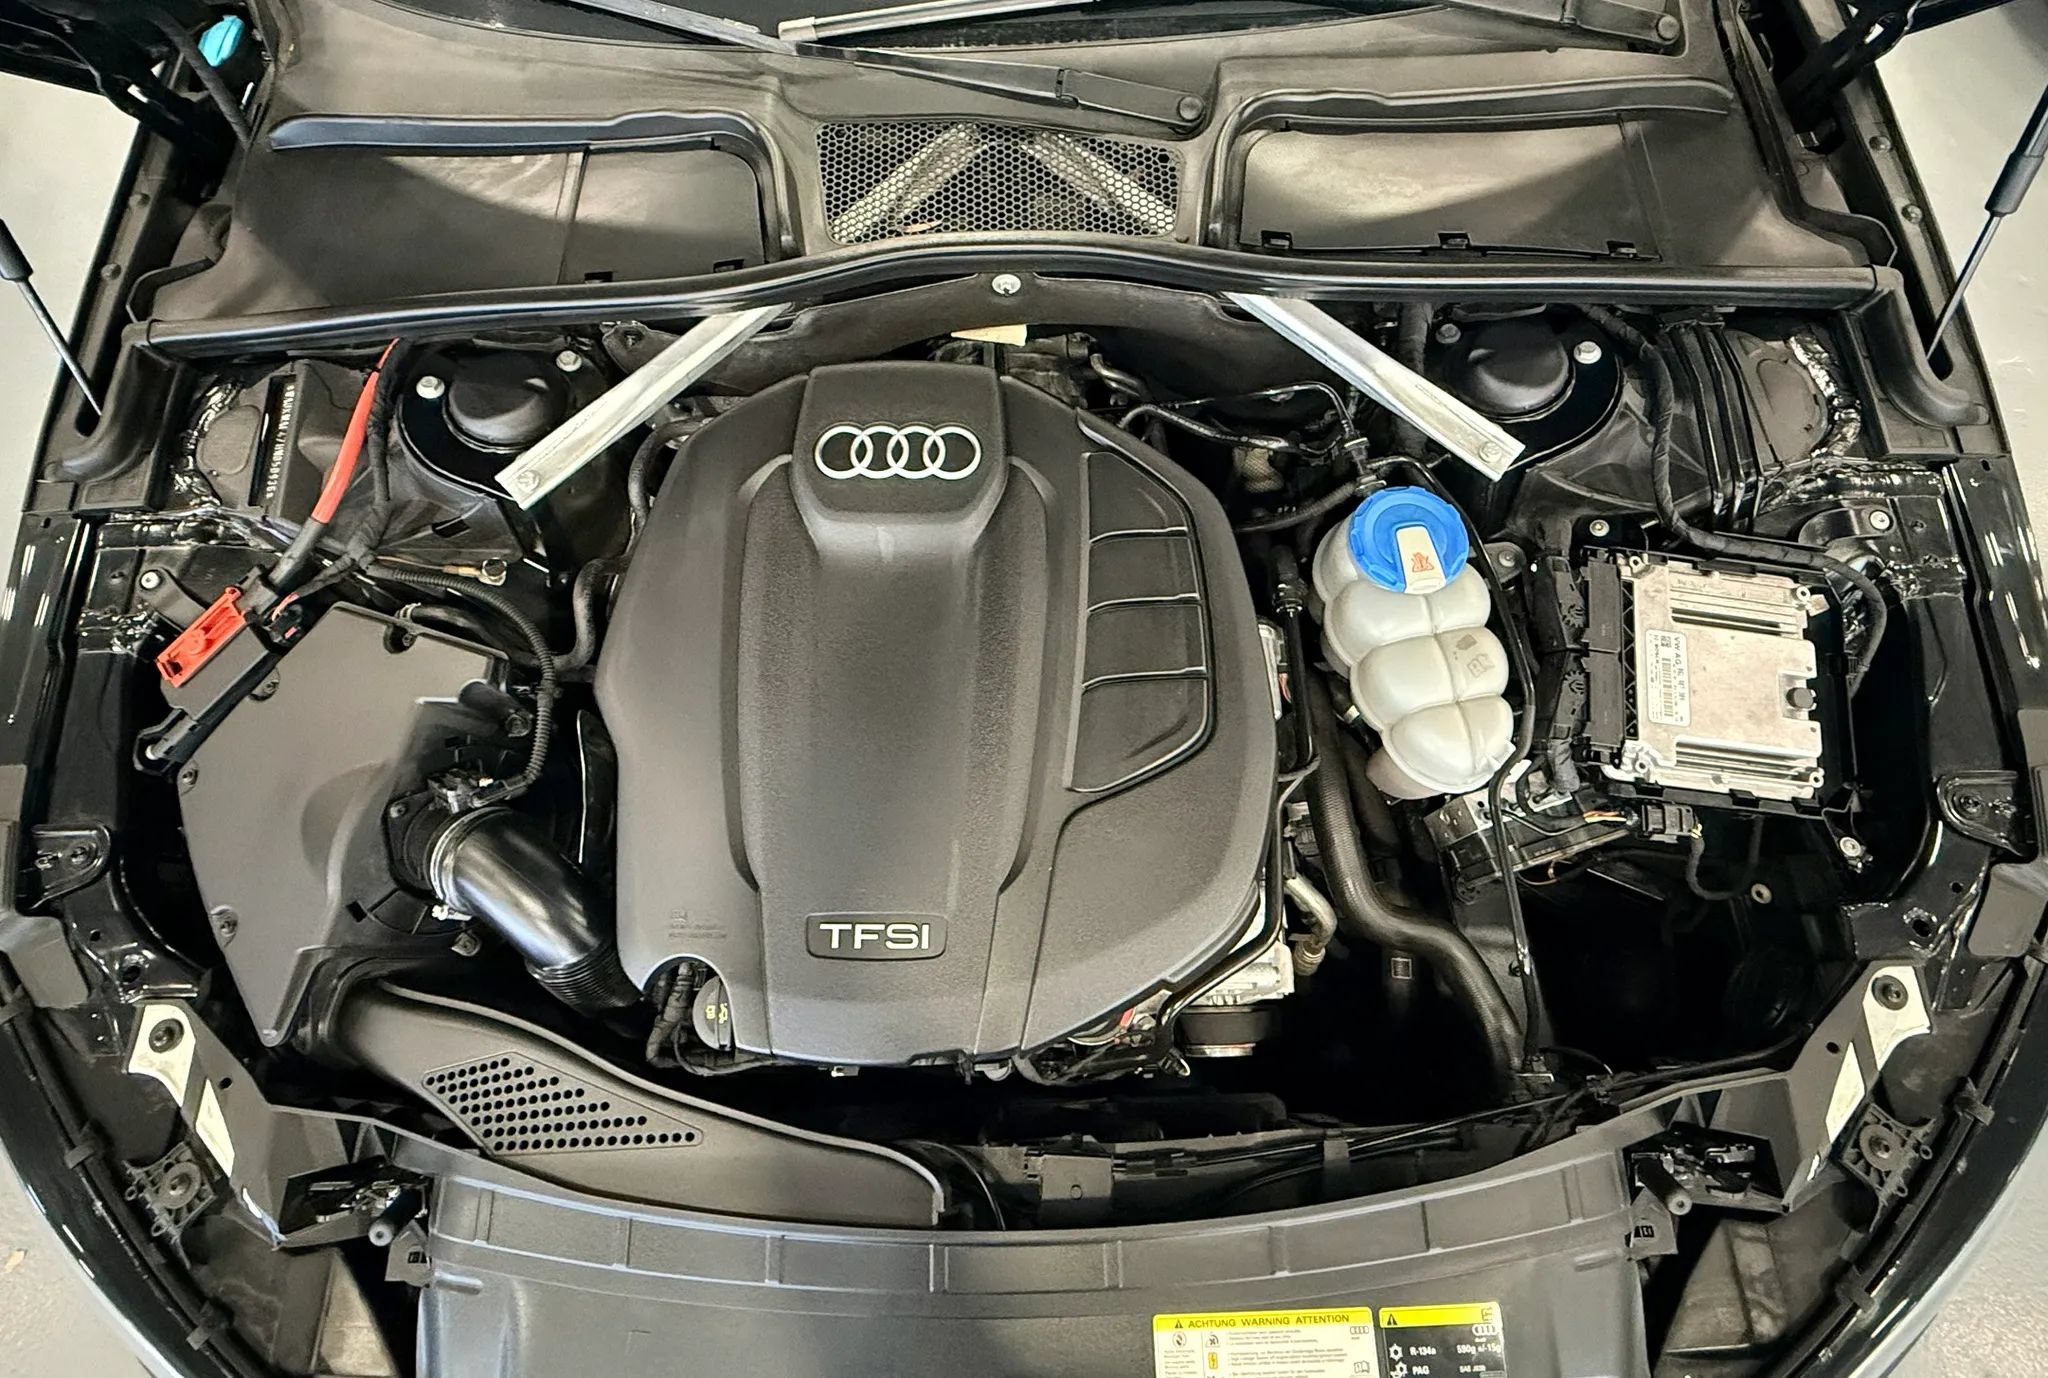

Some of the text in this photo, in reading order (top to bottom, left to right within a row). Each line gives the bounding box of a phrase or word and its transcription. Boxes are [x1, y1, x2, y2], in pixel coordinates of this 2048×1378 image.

[819, 923, 930, 949] TFSI
[1188, 1314, 1350, 1328] ACHTUNG WARNING ATTENTION
[1409, 1346, 1437, 1356] R-134a
[1412, 1365, 1430, 1376] PAG
